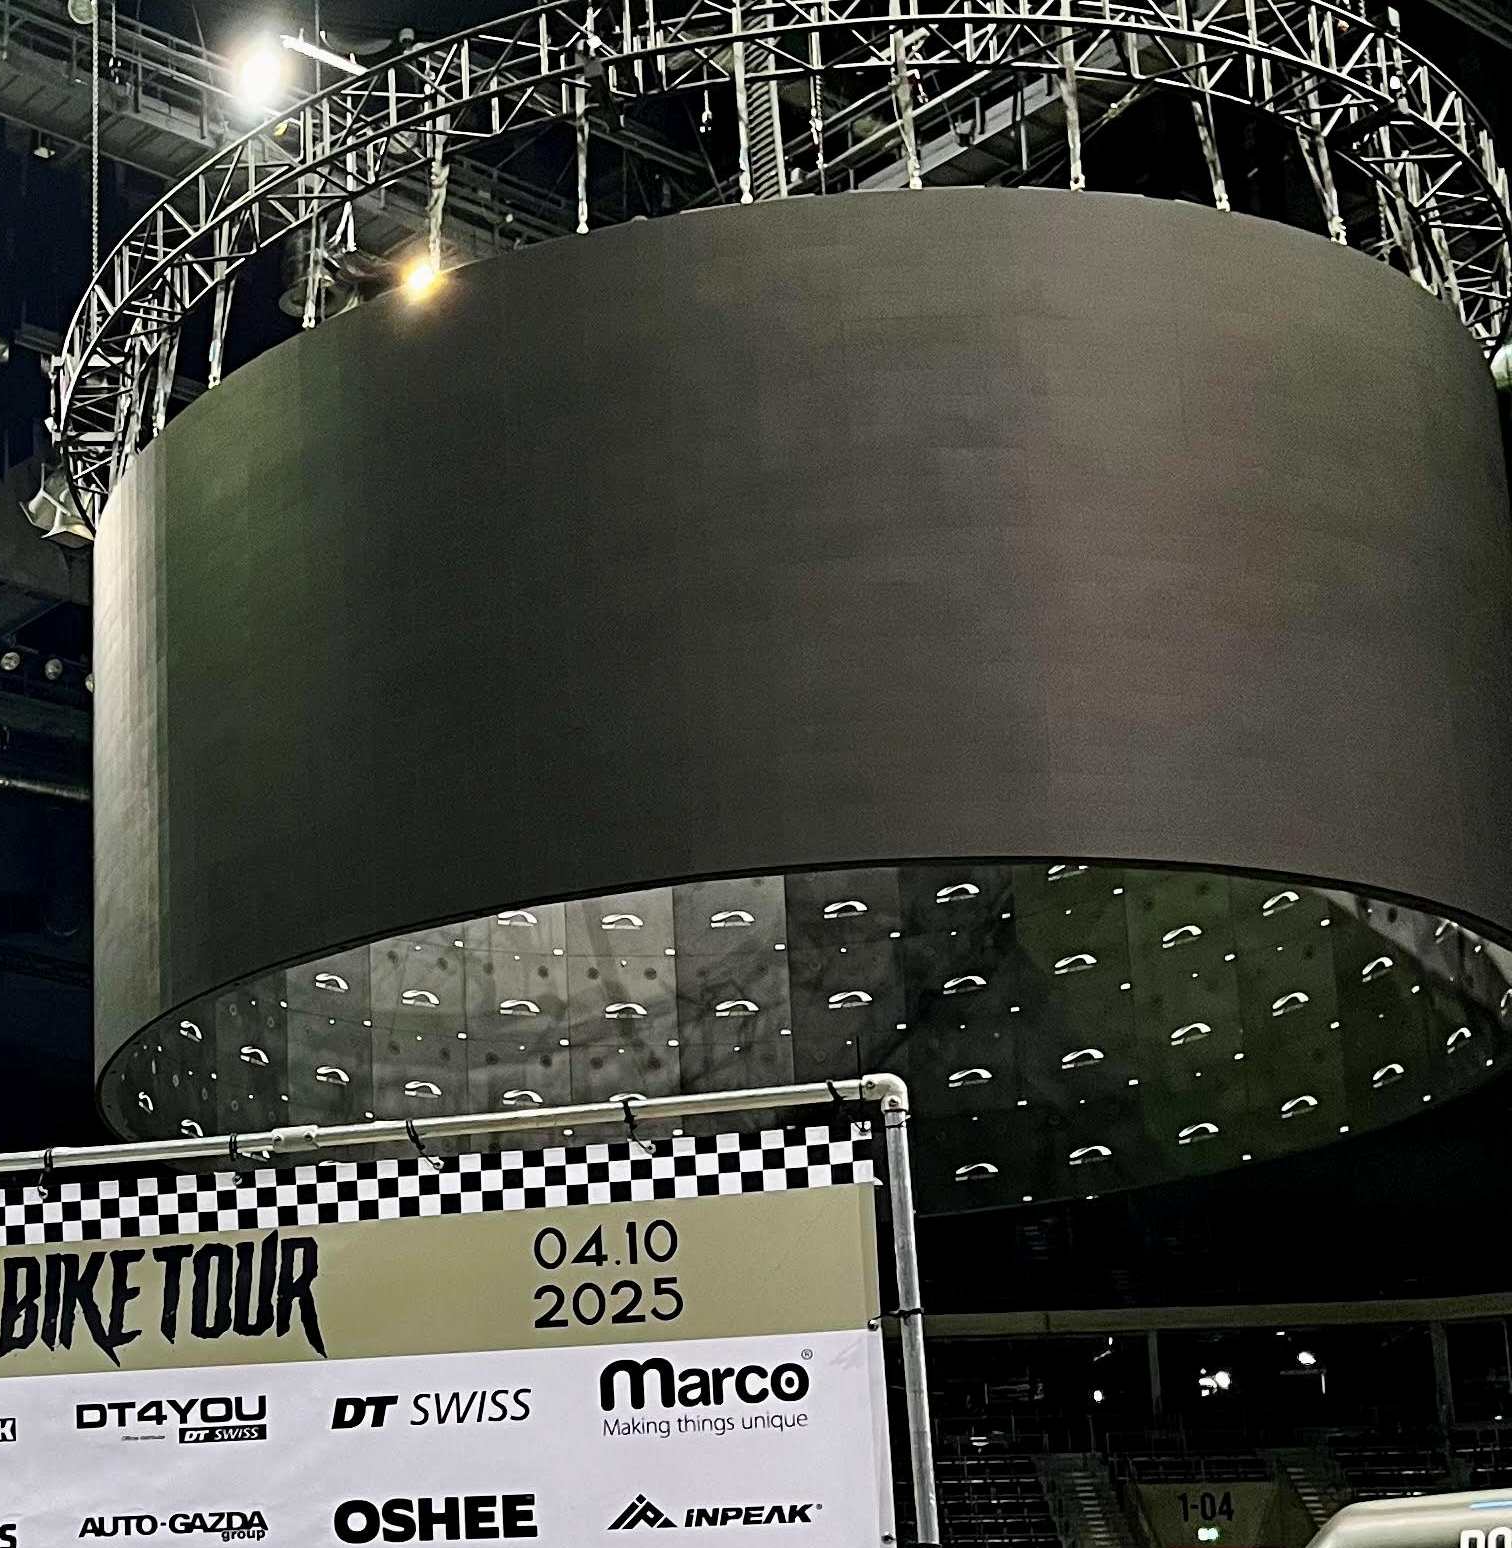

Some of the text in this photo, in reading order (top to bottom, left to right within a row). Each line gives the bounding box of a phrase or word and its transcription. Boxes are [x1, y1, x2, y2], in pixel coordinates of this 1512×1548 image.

[534, 1220, 677, 1269] 04.10
[0, 1248, 146, 1368] BIKE
[153, 1229, 328, 1359] TOUR
[534, 1277, 683, 1328] 2025
[76, 1395, 267, 1430] DT4YOU
[331, 1389, 531, 1429] DT SWISS
[604, 1414, 807, 1438] Making things unique
[184, 1426, 260, 1442] DT SWISS
[334, 1494, 537, 1544] OSHEE
[1178, 1493, 1234, 1521] 1-04
[221, 1529, 266, 1543] group
